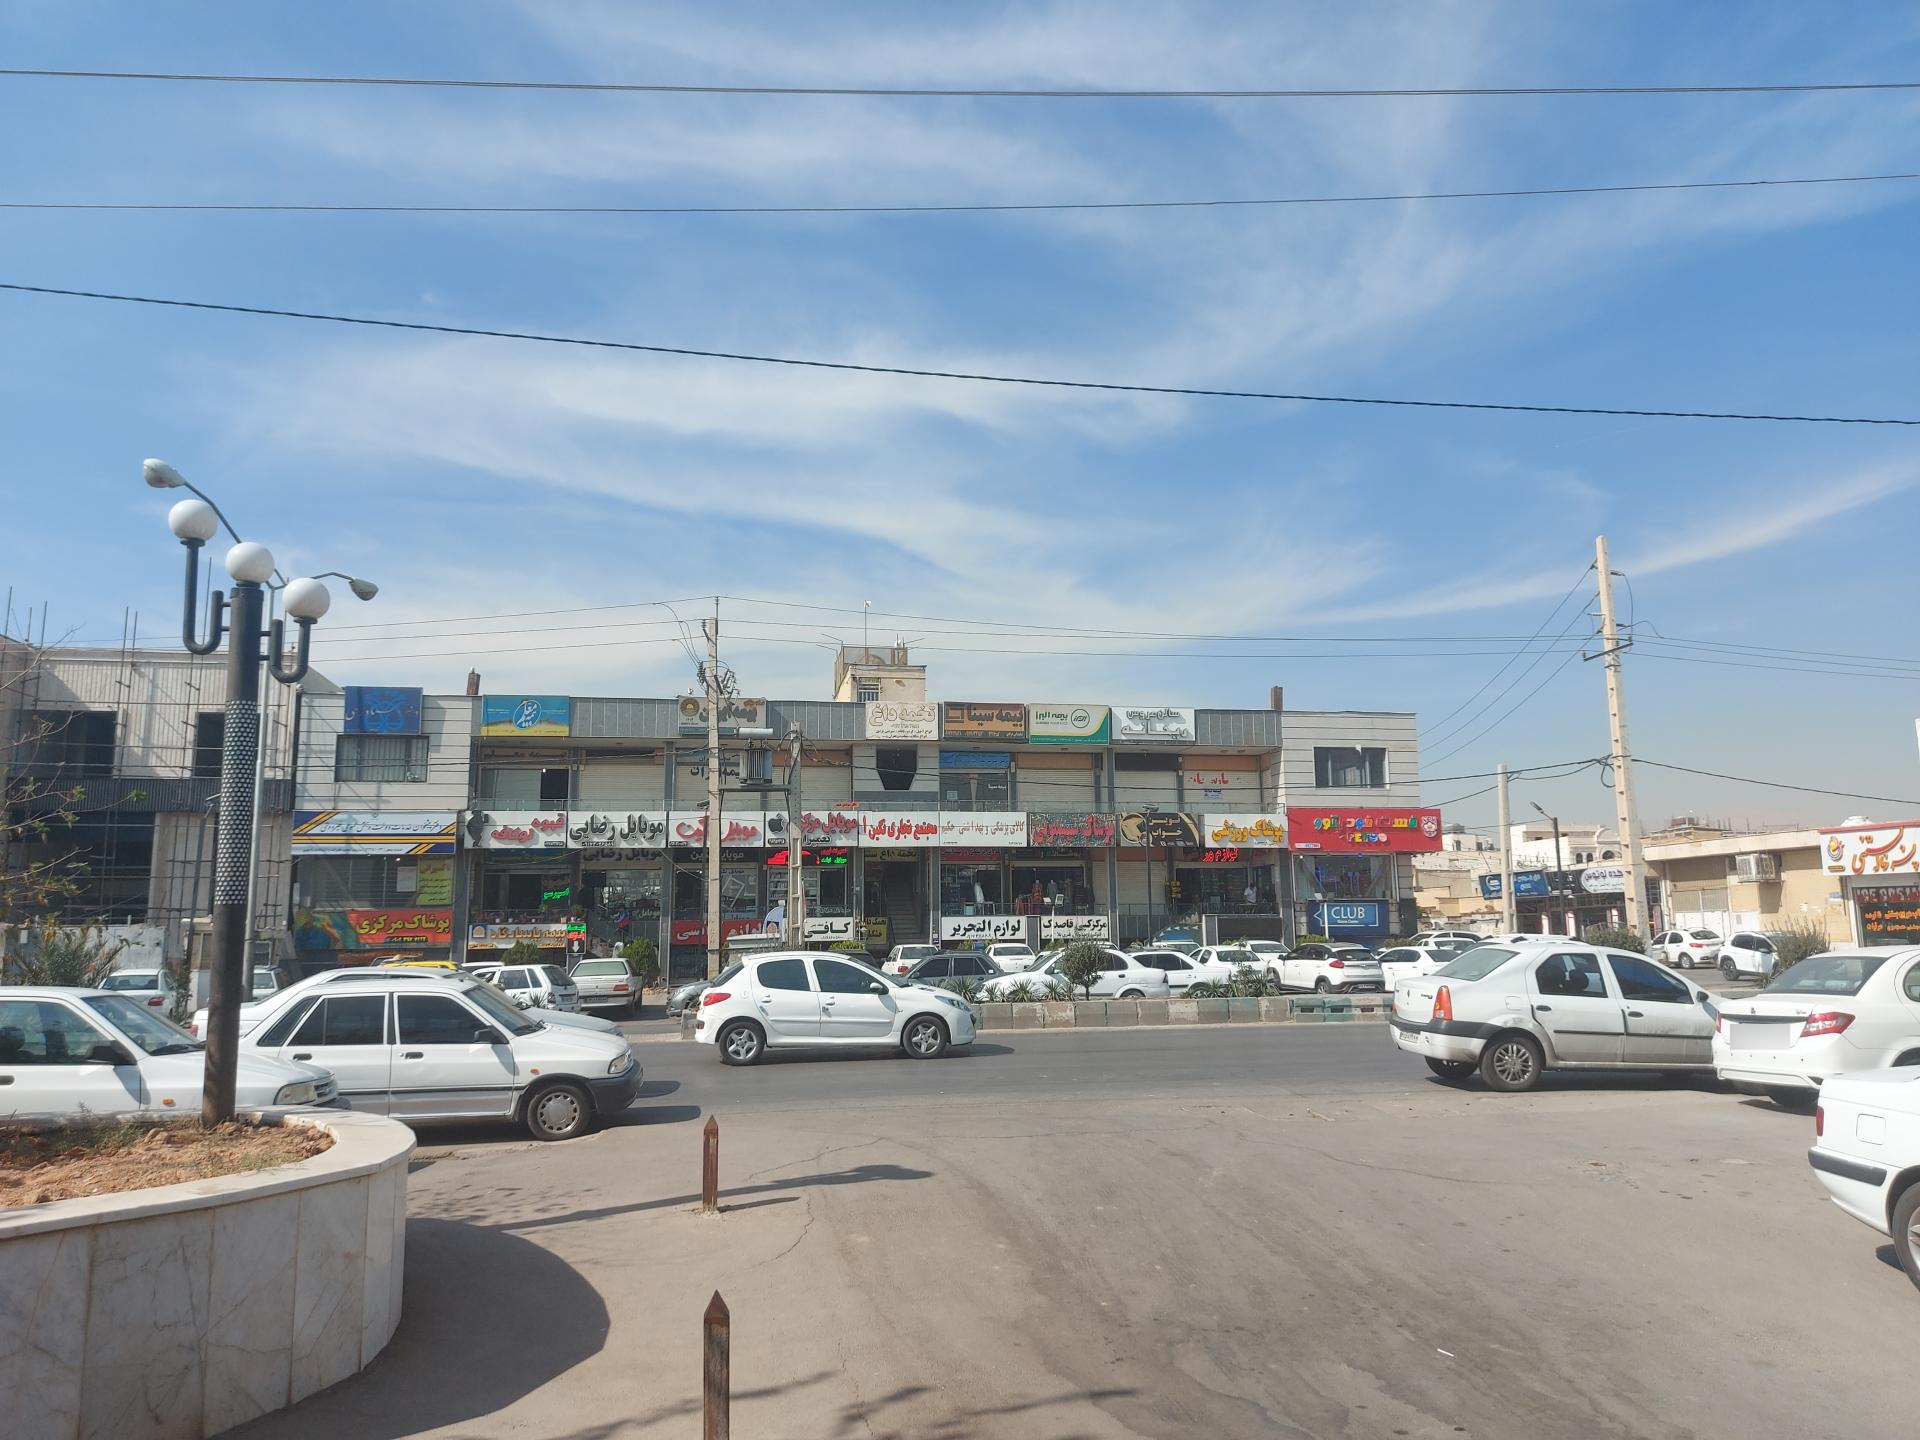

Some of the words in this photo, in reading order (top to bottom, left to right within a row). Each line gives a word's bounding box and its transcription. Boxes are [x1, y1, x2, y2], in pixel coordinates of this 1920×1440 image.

[869, 703, 897, 727] داغ
[899, 705, 936, 722] تخمه
[967, 703, 994, 726] سینا
[996, 707, 1023, 728] بیمه
[1035, 711, 1051, 721] البرز
[1051, 713, 1069, 721] بیمه
[531, 813, 565, 832] قهوه
[569, 813, 616, 841] رضایی
[620, 813, 664, 841] موبایل
[719, 820, 760, 843] موبایل
[822, 812, 857, 834] موبایل
[869, 818, 887, 841] نگین
[888, 817, 912, 841] تجاری
[913, 821, 938, 841] مجتمع
[985, 826, 989, 836] و
[990, 821, 1009, 836] پزشکی
[1009, 820, 1025, 835] کالای
[1081, 815, 1114, 846] پوشاک
[1212, 819, 1249, 843] ورزشی
[1250, 819, 1284, 843] پوشاک
[1346, 815, 1374, 829] فود
[1375, 815, 1418, 829] فست
[803, 833, 832, 846] تعمیرا
[1152, 826, 1183, 839] خواب
[1331, 906, 1365, 919] CLUB
[356, 914, 404, 935] مرکزی
[405, 912, 451, 934] پوشاک
[950, 919, 992, 937] التحریر
[994, 919, 1021, 939] لوازم
[1043, 919, 1073, 929] قاصدک
[1090, 919, 1108, 931] مرکز
[490, 926, 542, 942] پاسارگاد
[543, 928, 566, 942] بیمه
